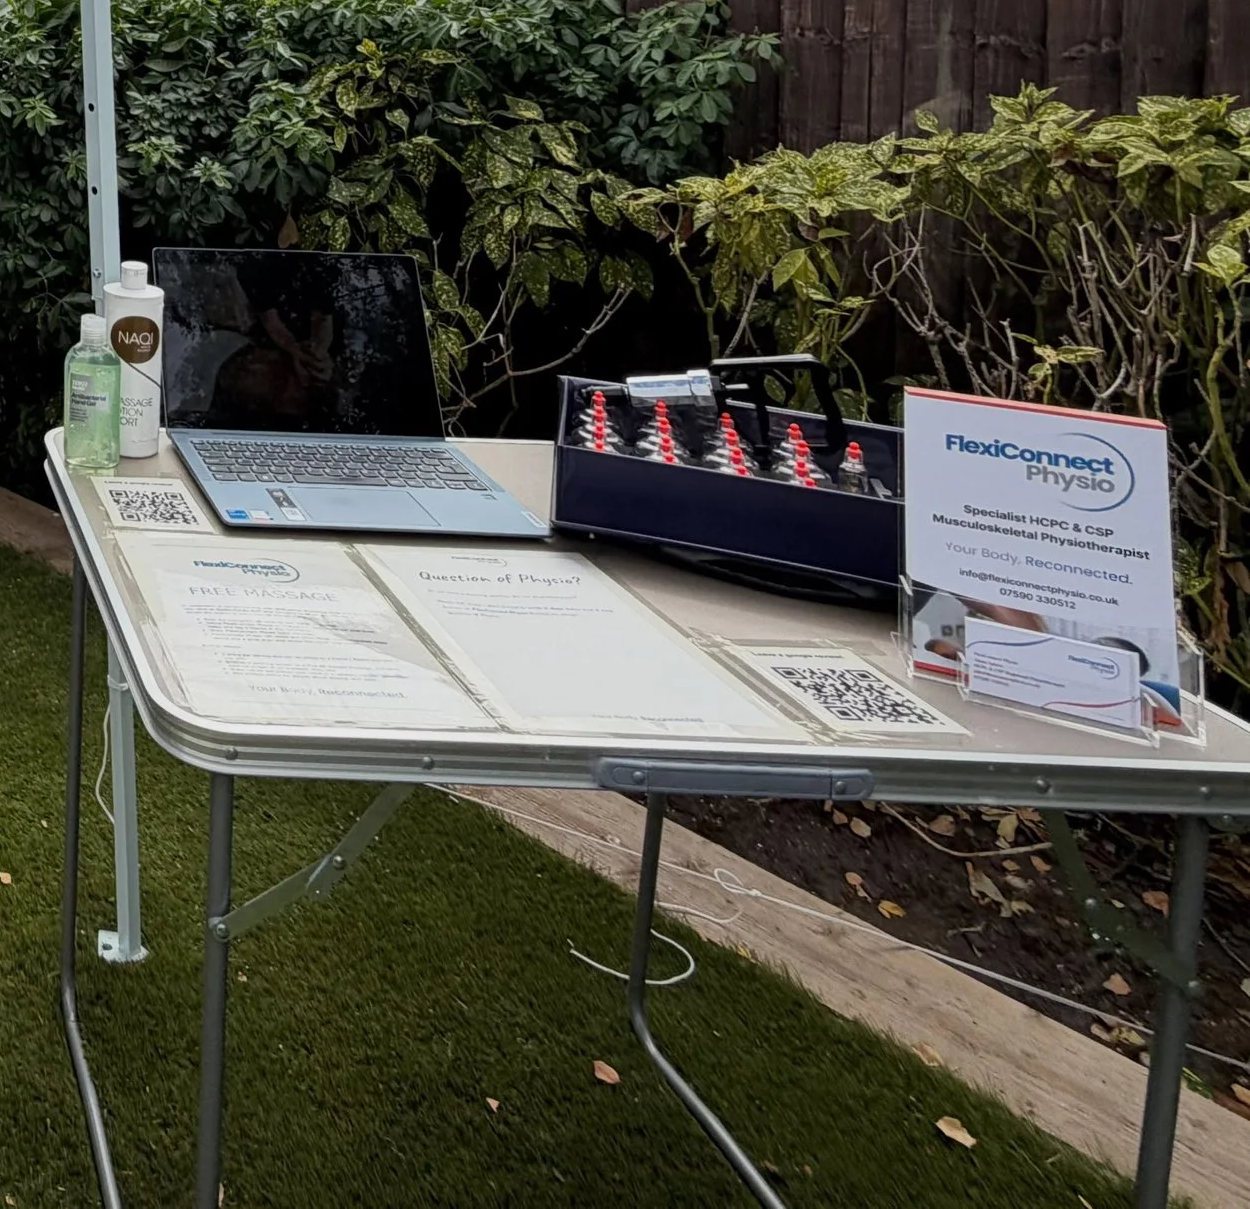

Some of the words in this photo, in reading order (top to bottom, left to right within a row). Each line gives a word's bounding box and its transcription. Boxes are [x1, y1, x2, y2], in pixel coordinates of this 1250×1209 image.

[118, 330, 154, 345] NAQI
[120, 397, 154, 407] ASSAGE
[120, 406, 144, 417] TION
[119, 416, 138, 427] ORT
[945, 434, 1115, 475] FlexiConnect
[1026, 464, 1115, 493] Physio
[963, 504, 1027, 524] Specialist
[1029, 515, 1069, 531] HCPC
[1072, 523, 1082, 533] &
[1085, 525, 1114, 538] CSP
[932, 513, 1038, 541] Musculoskeletal
[1040, 532, 1151, 560] Physiotherapist
[945, 542, 977, 556] Your
[981, 548, 1022, 566] Body,
[1025, 555, 1134, 585] Reconnected.
[419, 571, 491, 582] Question
[497, 573, 512, 584] of
[518, 573, 581, 586] Physio?
[959, 567, 1119, 606] info@flexiconnectphysio.co.uk
[189, 587, 238, 596] FREE
[244, 588, 341, 602] MASSAGE
[999, 587, 1033, 602] 07590
[1035, 594, 1077, 610] 330512
